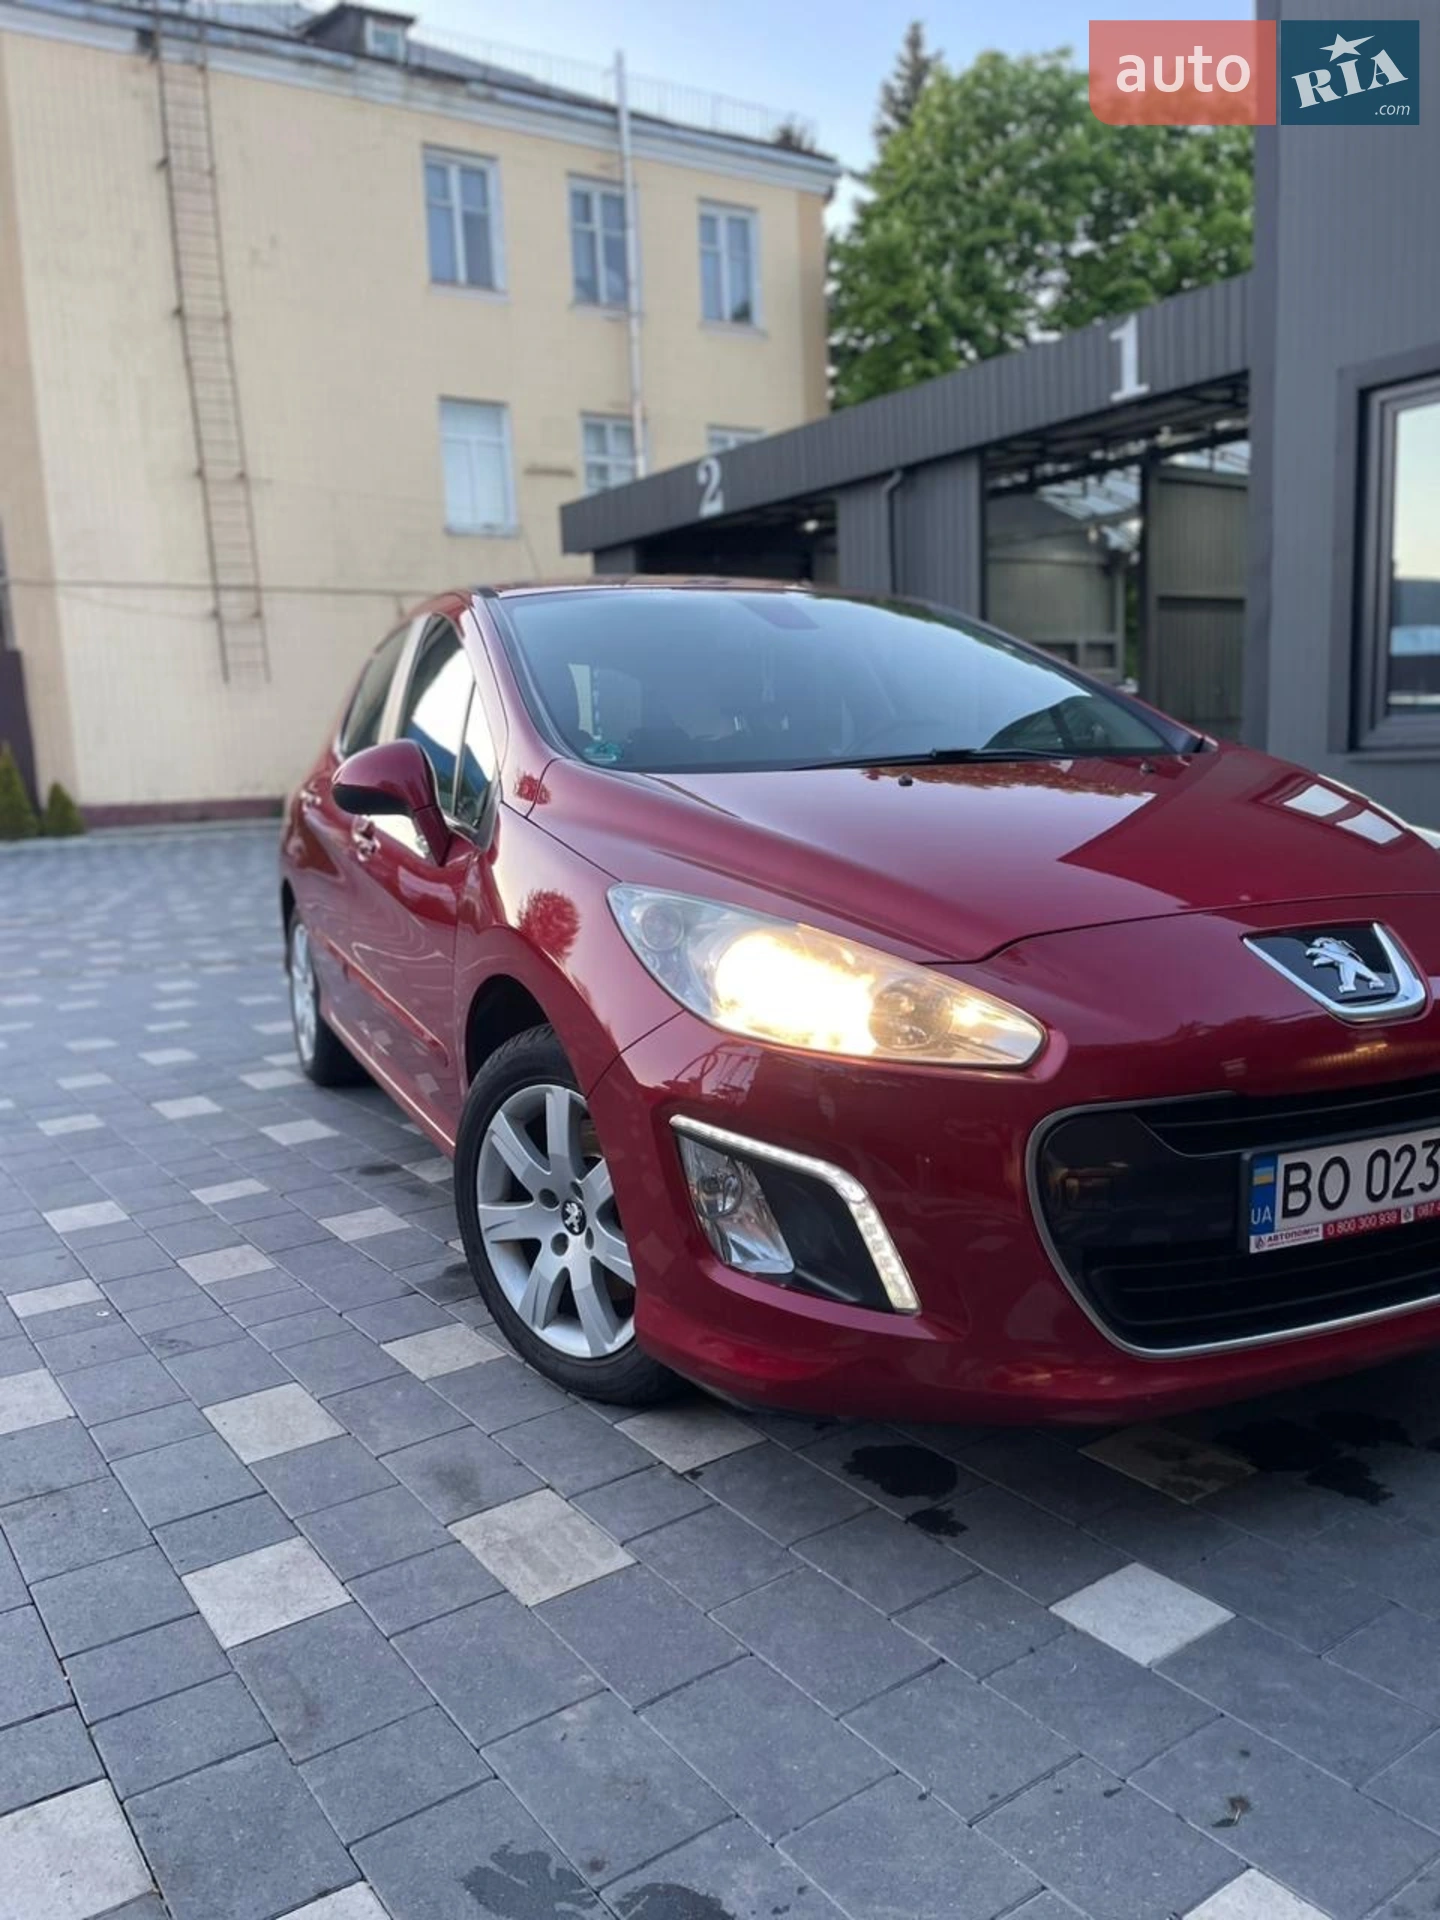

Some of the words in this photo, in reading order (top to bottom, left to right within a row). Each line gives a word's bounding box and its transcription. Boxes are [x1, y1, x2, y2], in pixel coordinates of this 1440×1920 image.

[1110, 314, 1150, 401] 1
[697, 457, 725, 517] 2
[1281, 1156, 1351, 1220] BO
[1366, 1137, 1440, 1203] 023
[1251, 1206, 1273, 1225] UA
[1326, 1223, 1335, 1236] 0
[1337, 1219, 1357, 1235] 800
[1358, 1214, 1378, 1230] 300
